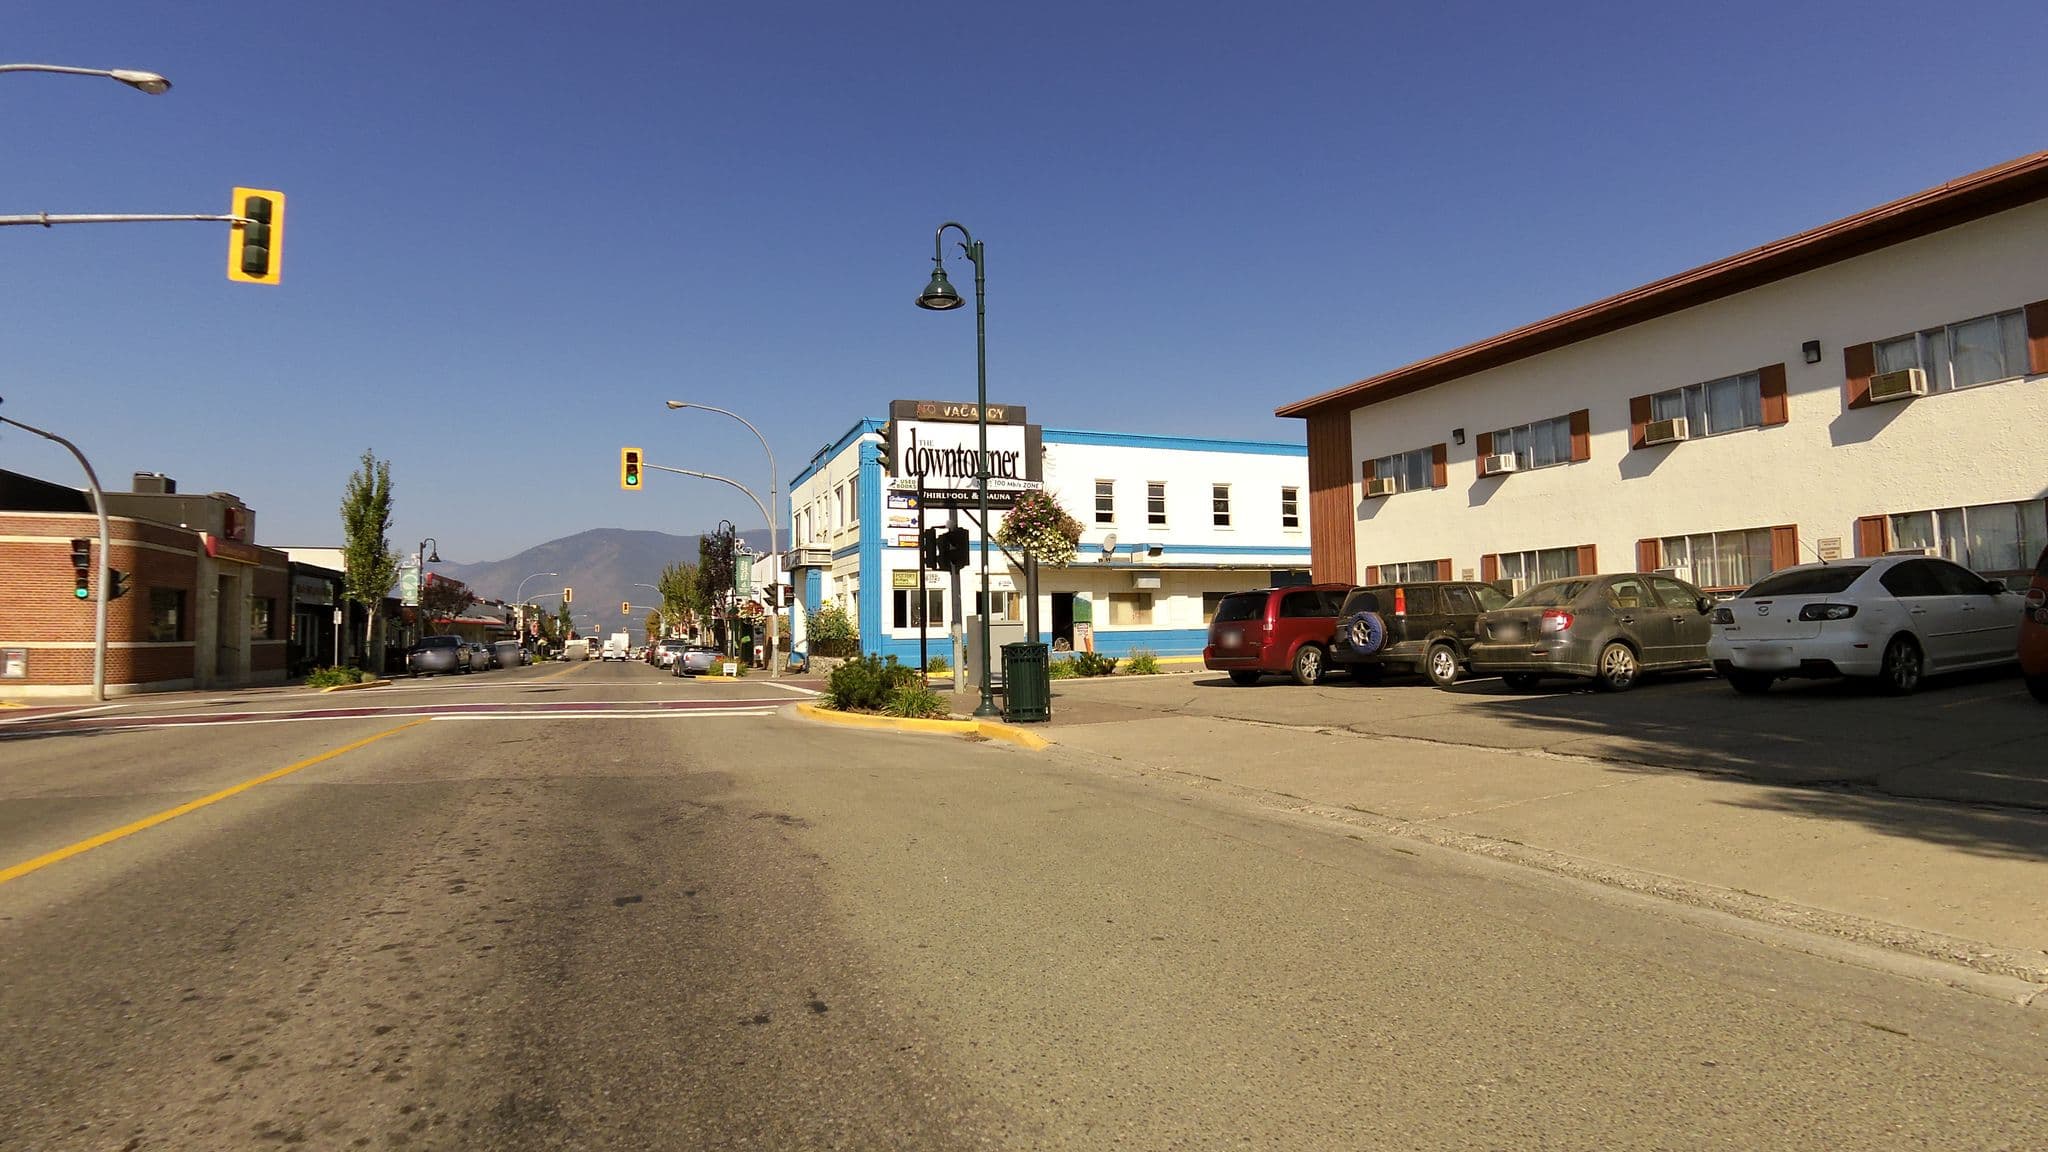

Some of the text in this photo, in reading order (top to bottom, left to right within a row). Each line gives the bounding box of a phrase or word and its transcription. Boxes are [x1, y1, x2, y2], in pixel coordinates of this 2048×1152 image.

[944, 406, 1004, 419] VACACY
[919, 439, 935, 447] THE
[905, 427, 1020, 479] downtowner
[971, 491, 979, 499] &
